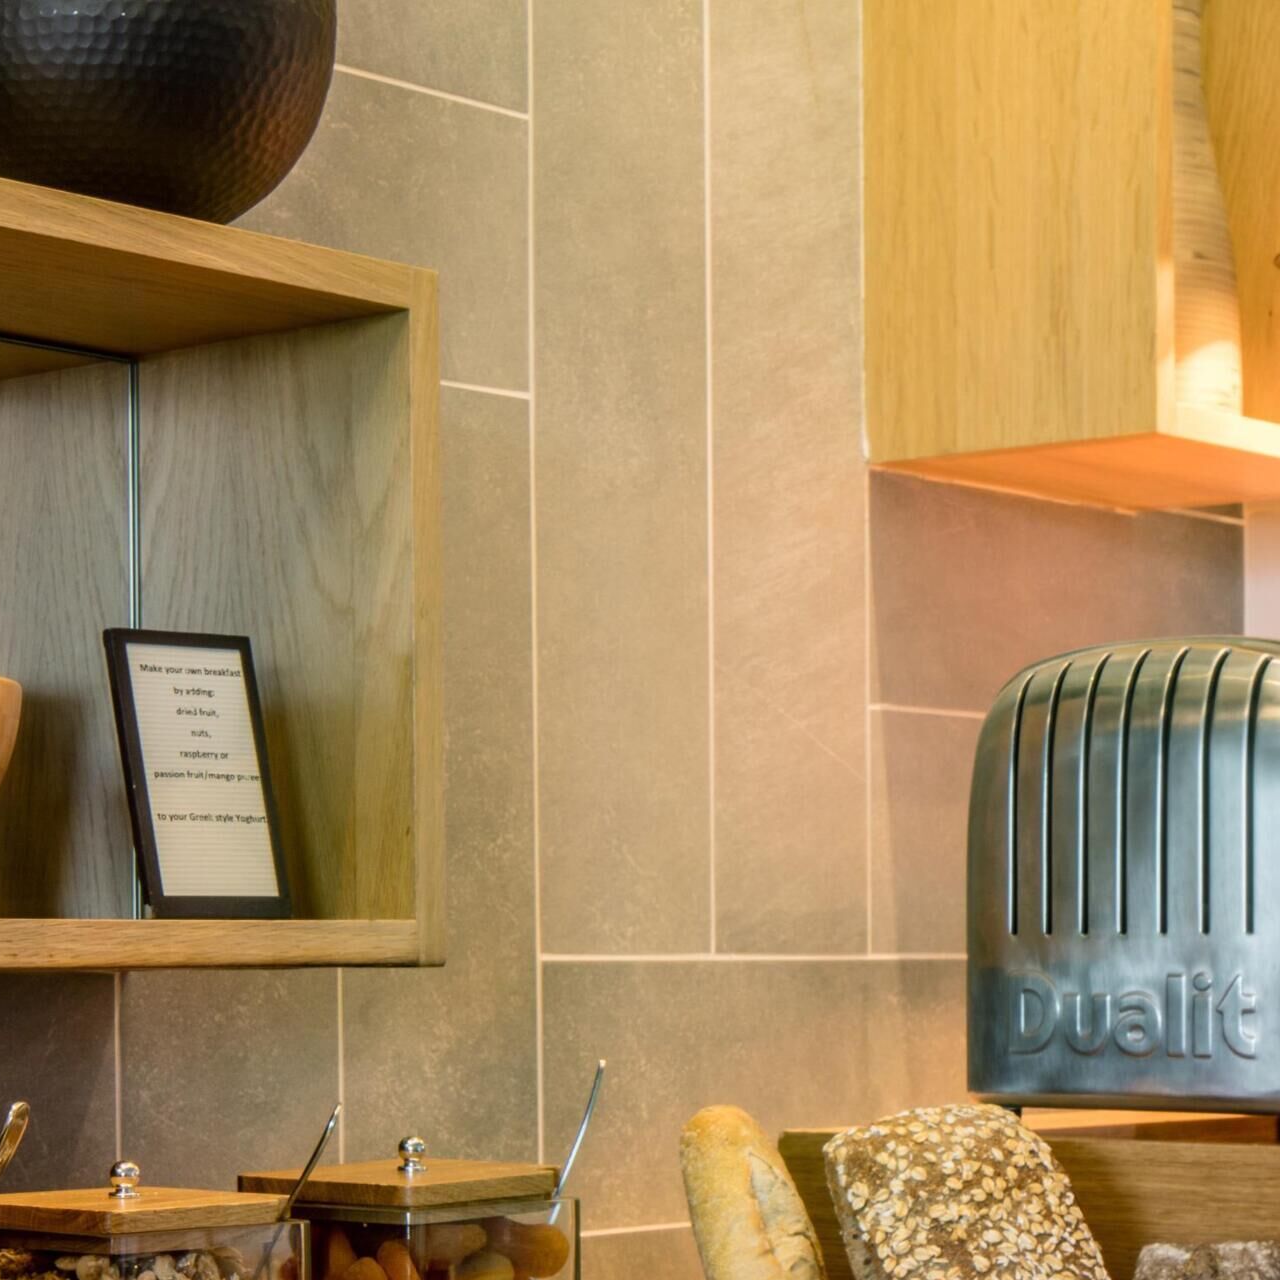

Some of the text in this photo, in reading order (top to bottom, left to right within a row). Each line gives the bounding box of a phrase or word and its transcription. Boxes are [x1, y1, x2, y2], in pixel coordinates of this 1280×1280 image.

[139, 663, 163, 673] Make
[164, 666, 183, 675] your
[203, 666, 241, 678] breakfast
[173, 686, 184, 697] by
[180, 749, 229, 761] raspberry or
[153, 770, 186, 779] passion
[157, 812, 167, 821] to
[168, 813, 188, 822] your
[215, 813, 234, 824] style
[1007, 967, 1258, 1060] Dualit
